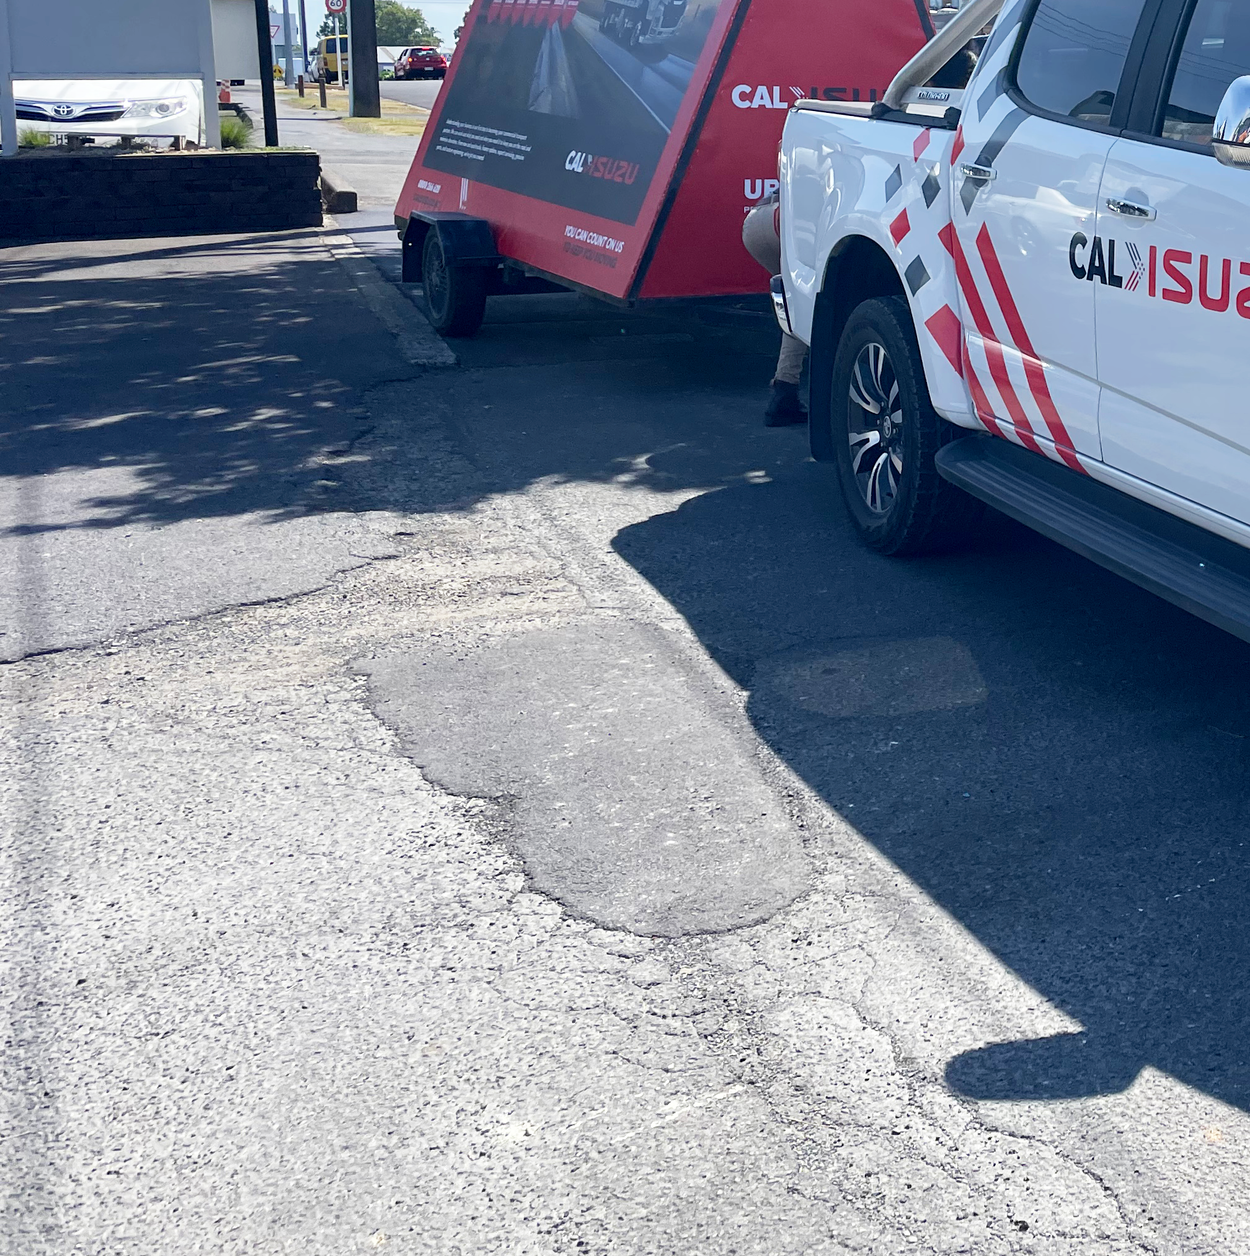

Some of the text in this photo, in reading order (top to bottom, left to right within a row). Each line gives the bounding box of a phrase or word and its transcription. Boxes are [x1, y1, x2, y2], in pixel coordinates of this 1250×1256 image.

[330, 0, 342, 7] 60
[731, 84, 788, 109] CAL
[565, 150, 639, 185] CAL ISUZU
[564, 225, 625, 253] YOU CAN COUNT ON US
[1069, 231, 1123, 288] CAL
